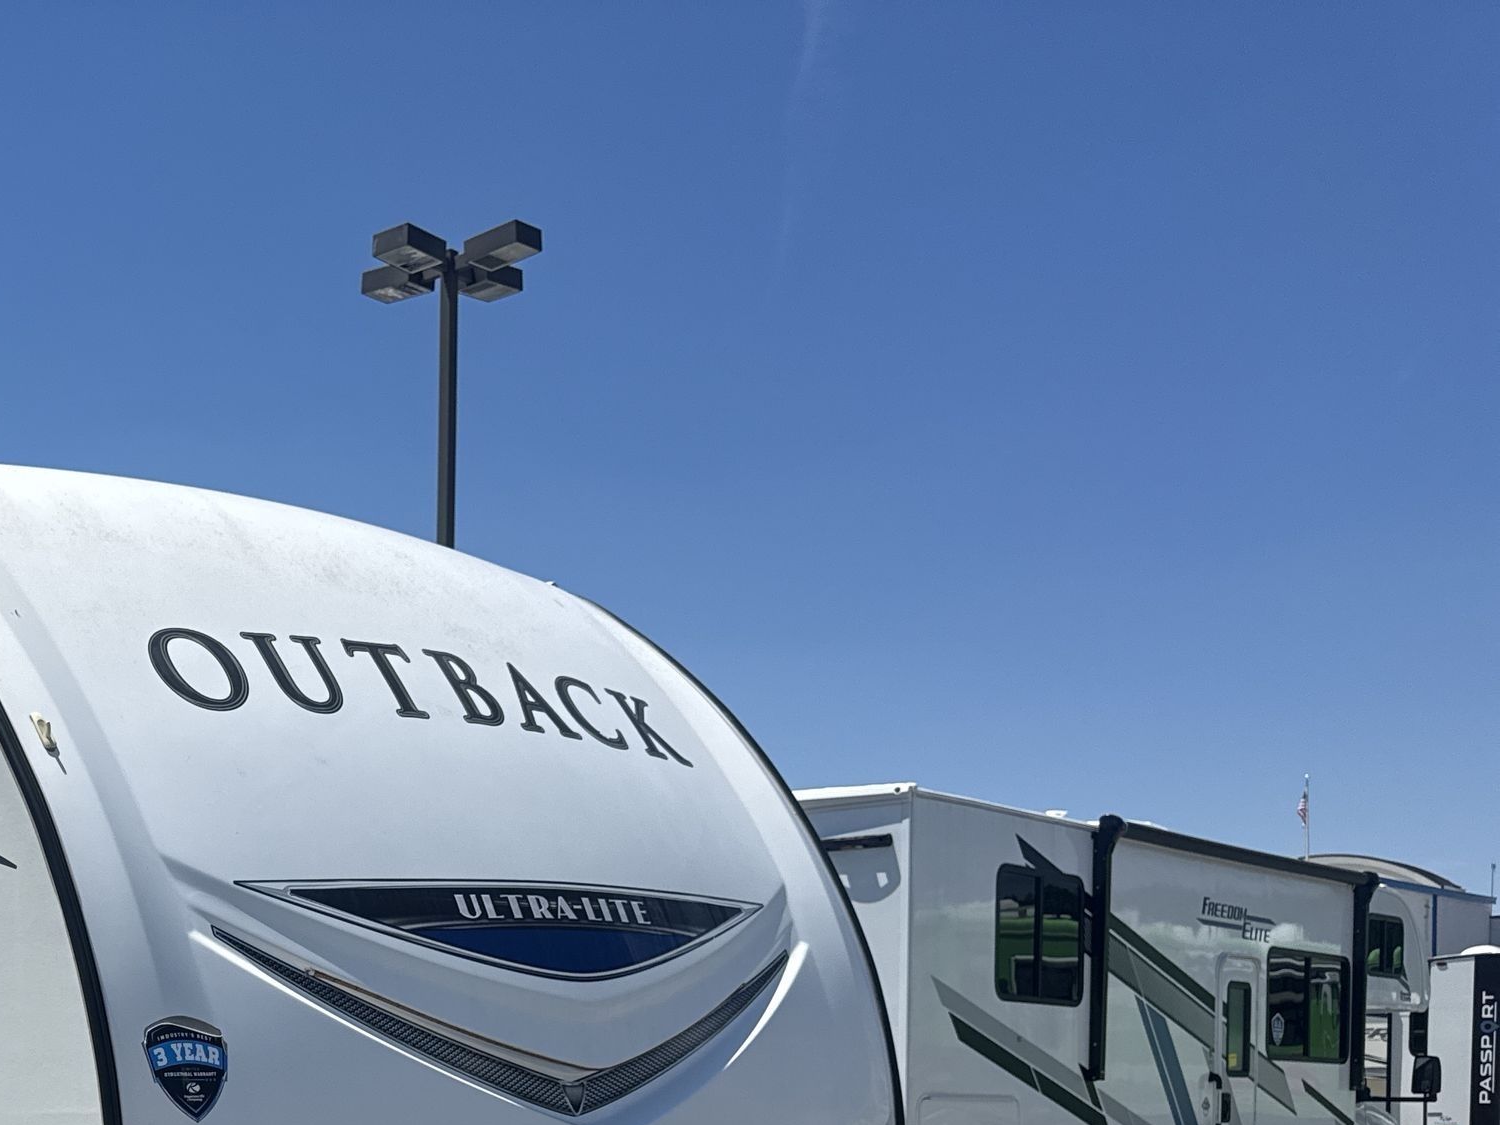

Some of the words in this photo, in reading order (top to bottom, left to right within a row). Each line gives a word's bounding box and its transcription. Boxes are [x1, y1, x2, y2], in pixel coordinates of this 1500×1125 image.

[147, 627, 694, 768] OUTBACK
[453, 893, 652, 925] ULTRA-LITE
[1201, 896, 1248, 921] FREEDOM
[1242, 919, 1272, 943] ELITE
[196, 1033, 213, 1042] BEST
[1479, 990, 1497, 1105] PASSPORT
[152, 1046, 168, 1067] 3
[170, 1042, 220, 1066] YEAR
